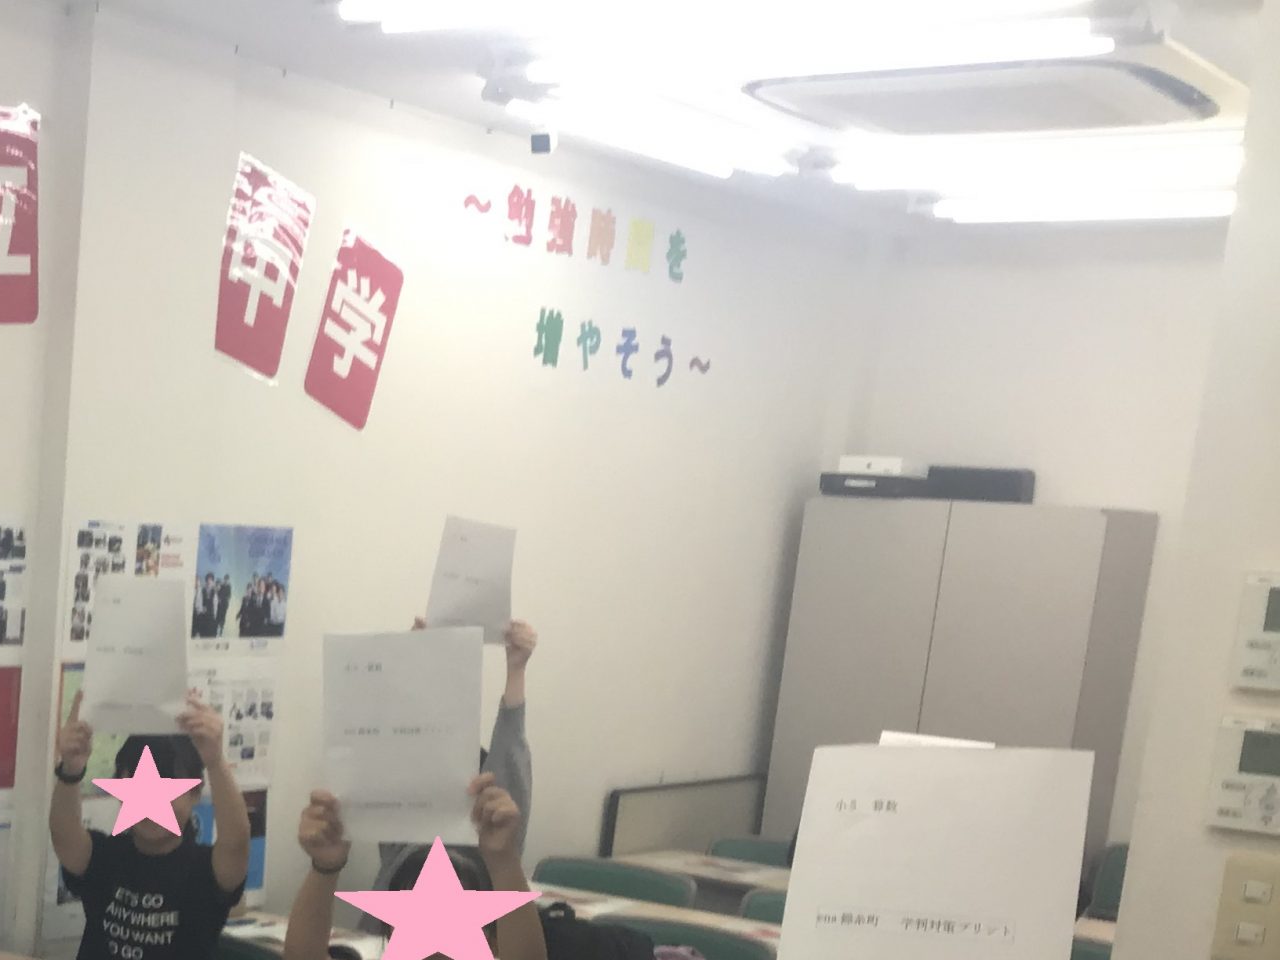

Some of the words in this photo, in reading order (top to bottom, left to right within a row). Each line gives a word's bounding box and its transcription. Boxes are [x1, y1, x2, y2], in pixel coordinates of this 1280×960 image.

[102, 919, 130, 942] YOU
[131, 930, 174, 945] WANT
[121, 944, 144, 960] GO
